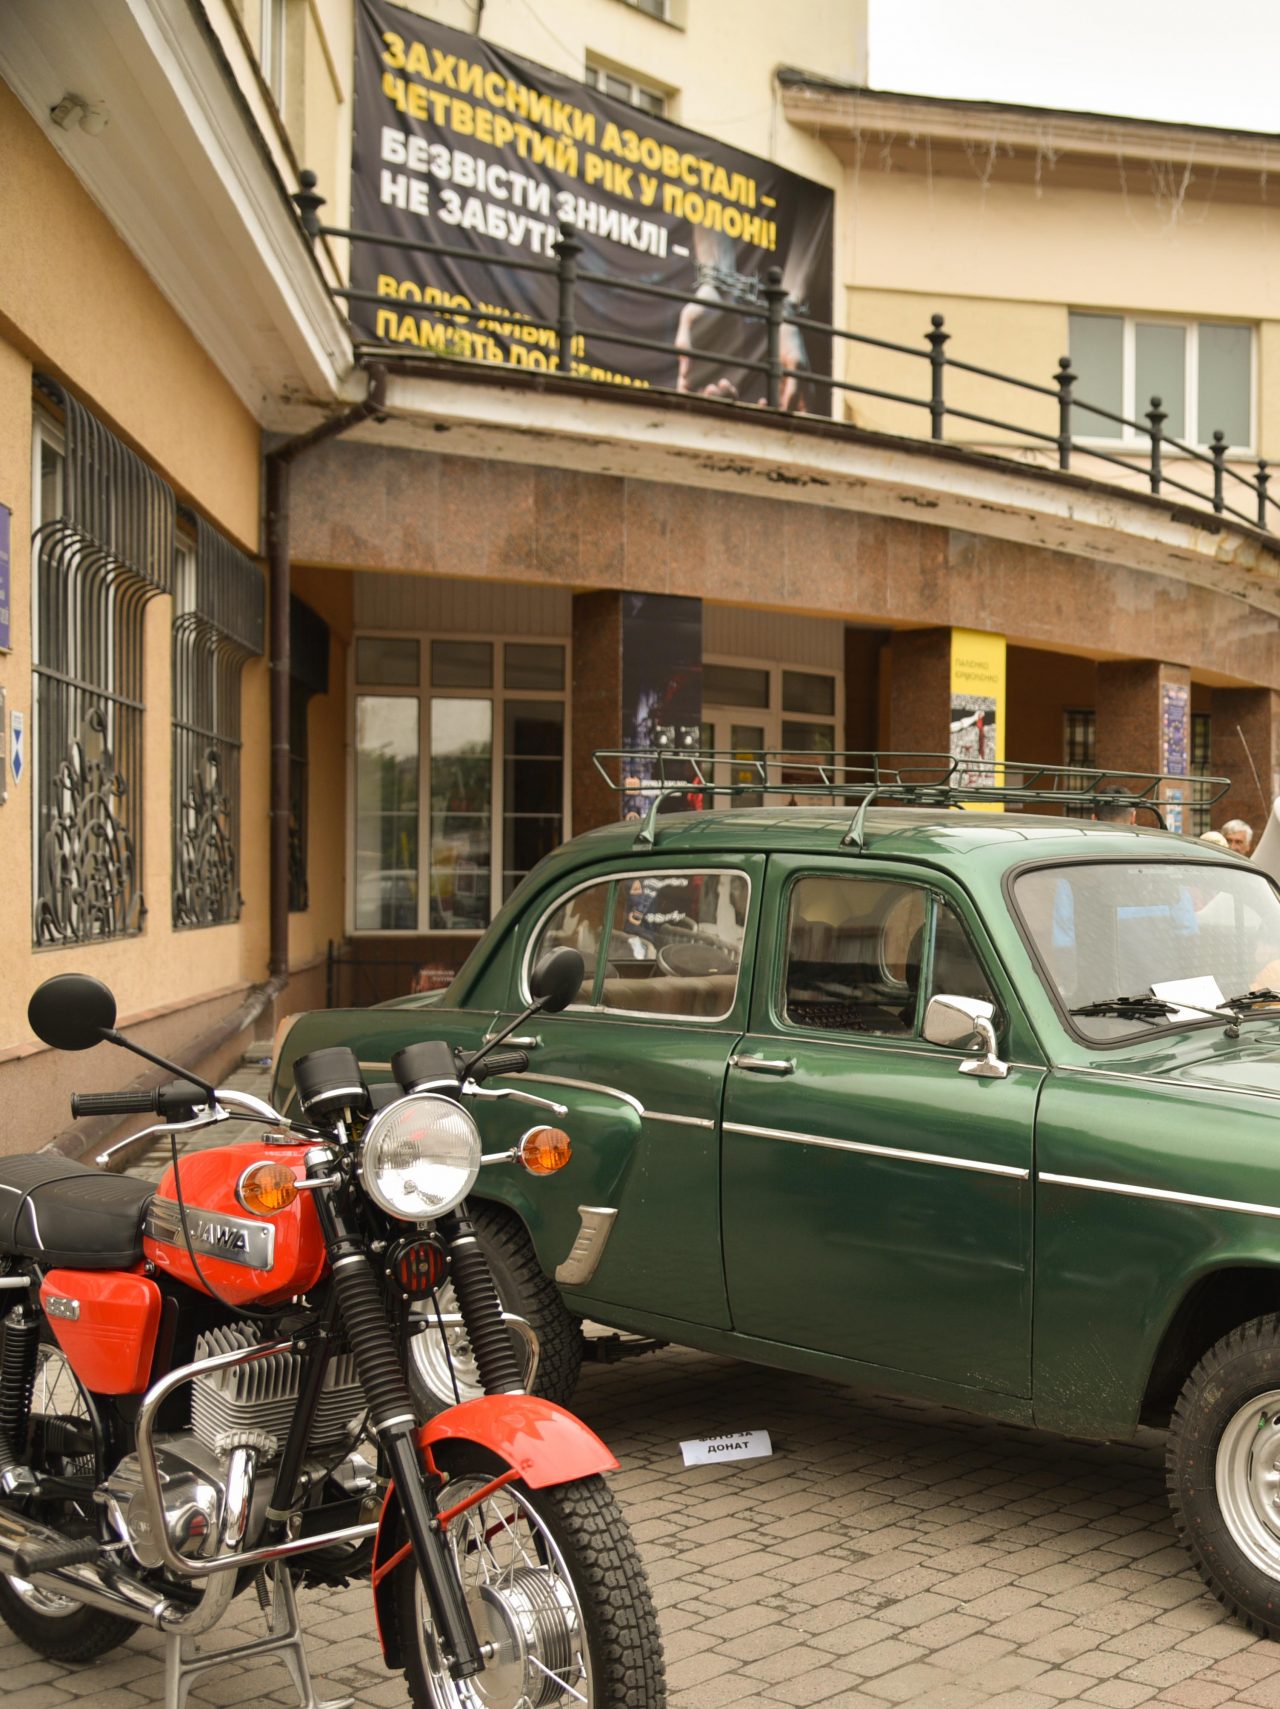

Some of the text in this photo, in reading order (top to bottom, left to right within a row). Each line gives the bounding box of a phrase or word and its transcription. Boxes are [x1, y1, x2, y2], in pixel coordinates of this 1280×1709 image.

[381, 31, 597, 147] ЗАХИСНИКИ
[601, 121, 757, 209] АЗОВСТАЛІ
[381, 71, 777, 252] ЧЕТВЕРТИЙ РІК У ПОЛОНІ!
[380, 168, 430, 217] НЕ
[381, 125, 551, 217] БЕЗВІСТИ
[556, 190, 668, 259] ЗНИКЛІ
[190, 1219, 250, 1253] JAWA
[708, 1441, 749, 1454] ДОНАТ
